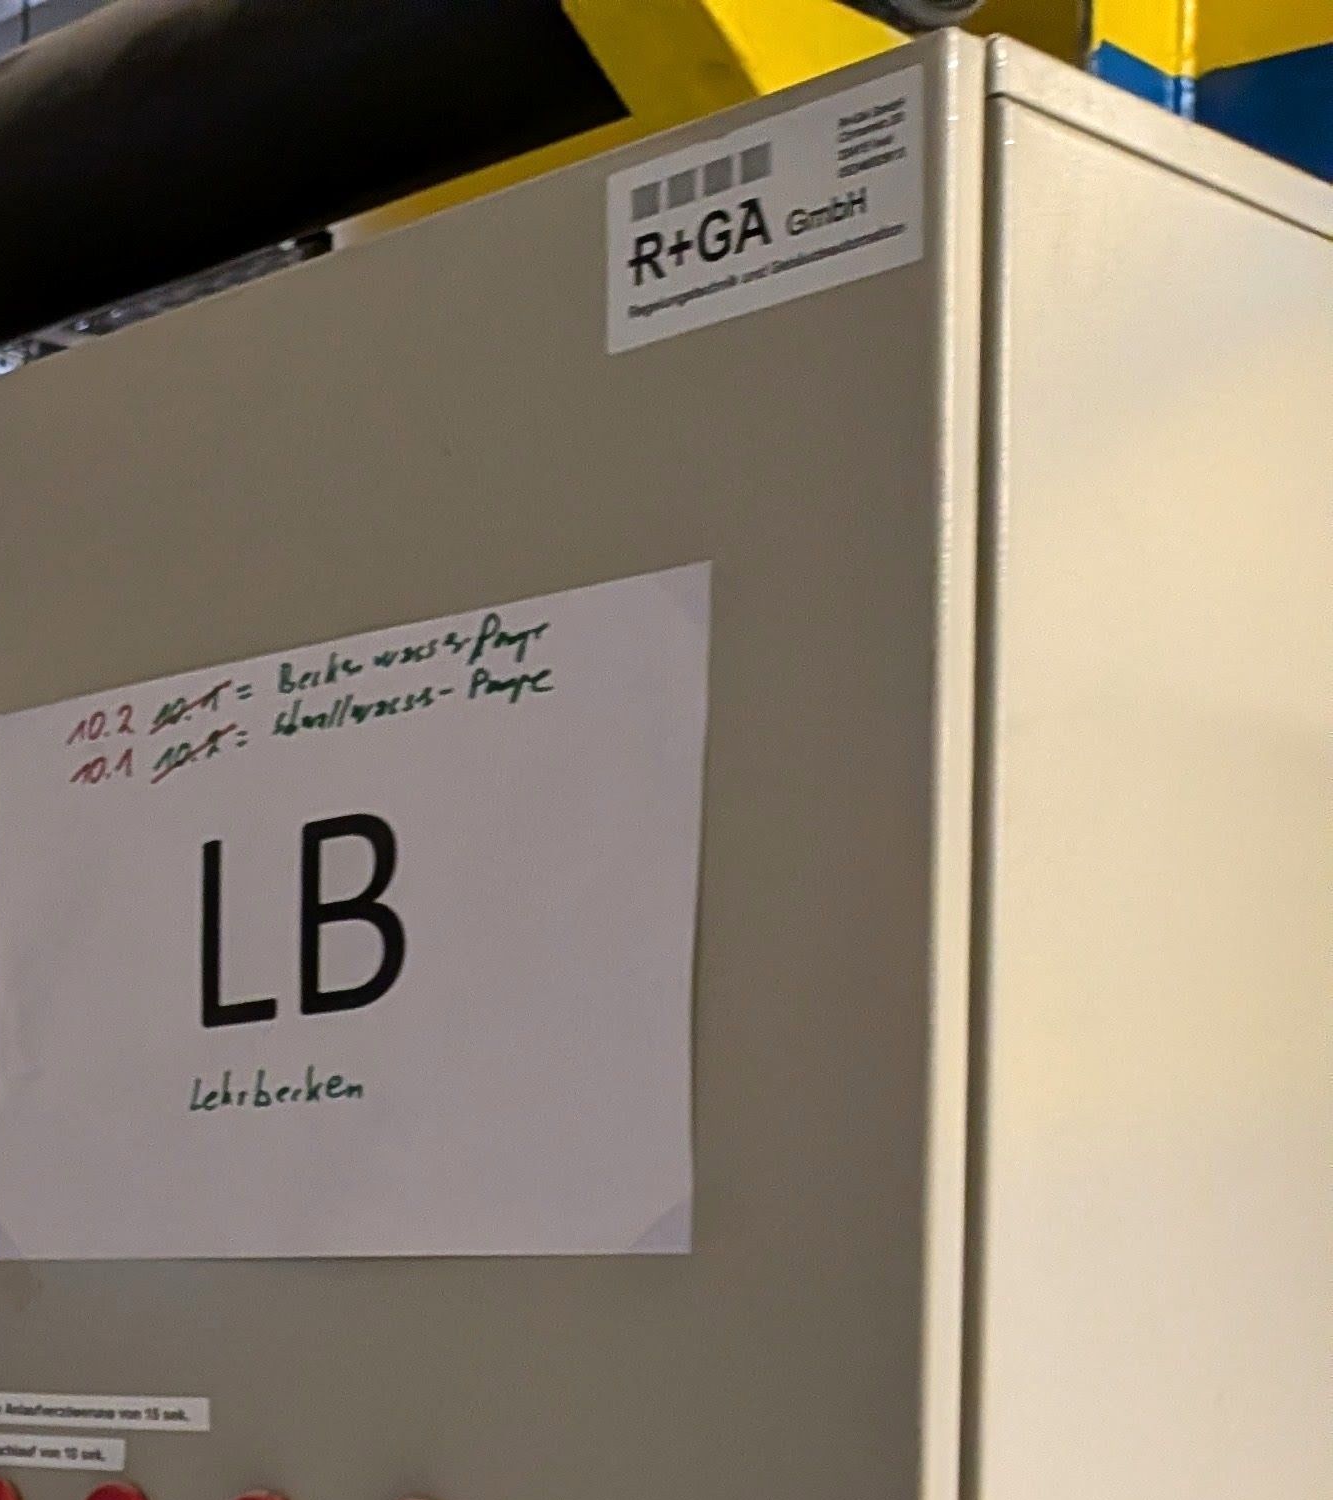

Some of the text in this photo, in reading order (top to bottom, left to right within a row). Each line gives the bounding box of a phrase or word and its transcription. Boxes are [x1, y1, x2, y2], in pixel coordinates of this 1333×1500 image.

[628, 186, 868, 286] R+GA GmbH
[66, 704, 135, 746] 10.2
[69, 747, 134, 784] 10.1
[201, 812, 406, 1029] LB
[189, 1063, 364, 1112] Lehrbecken
